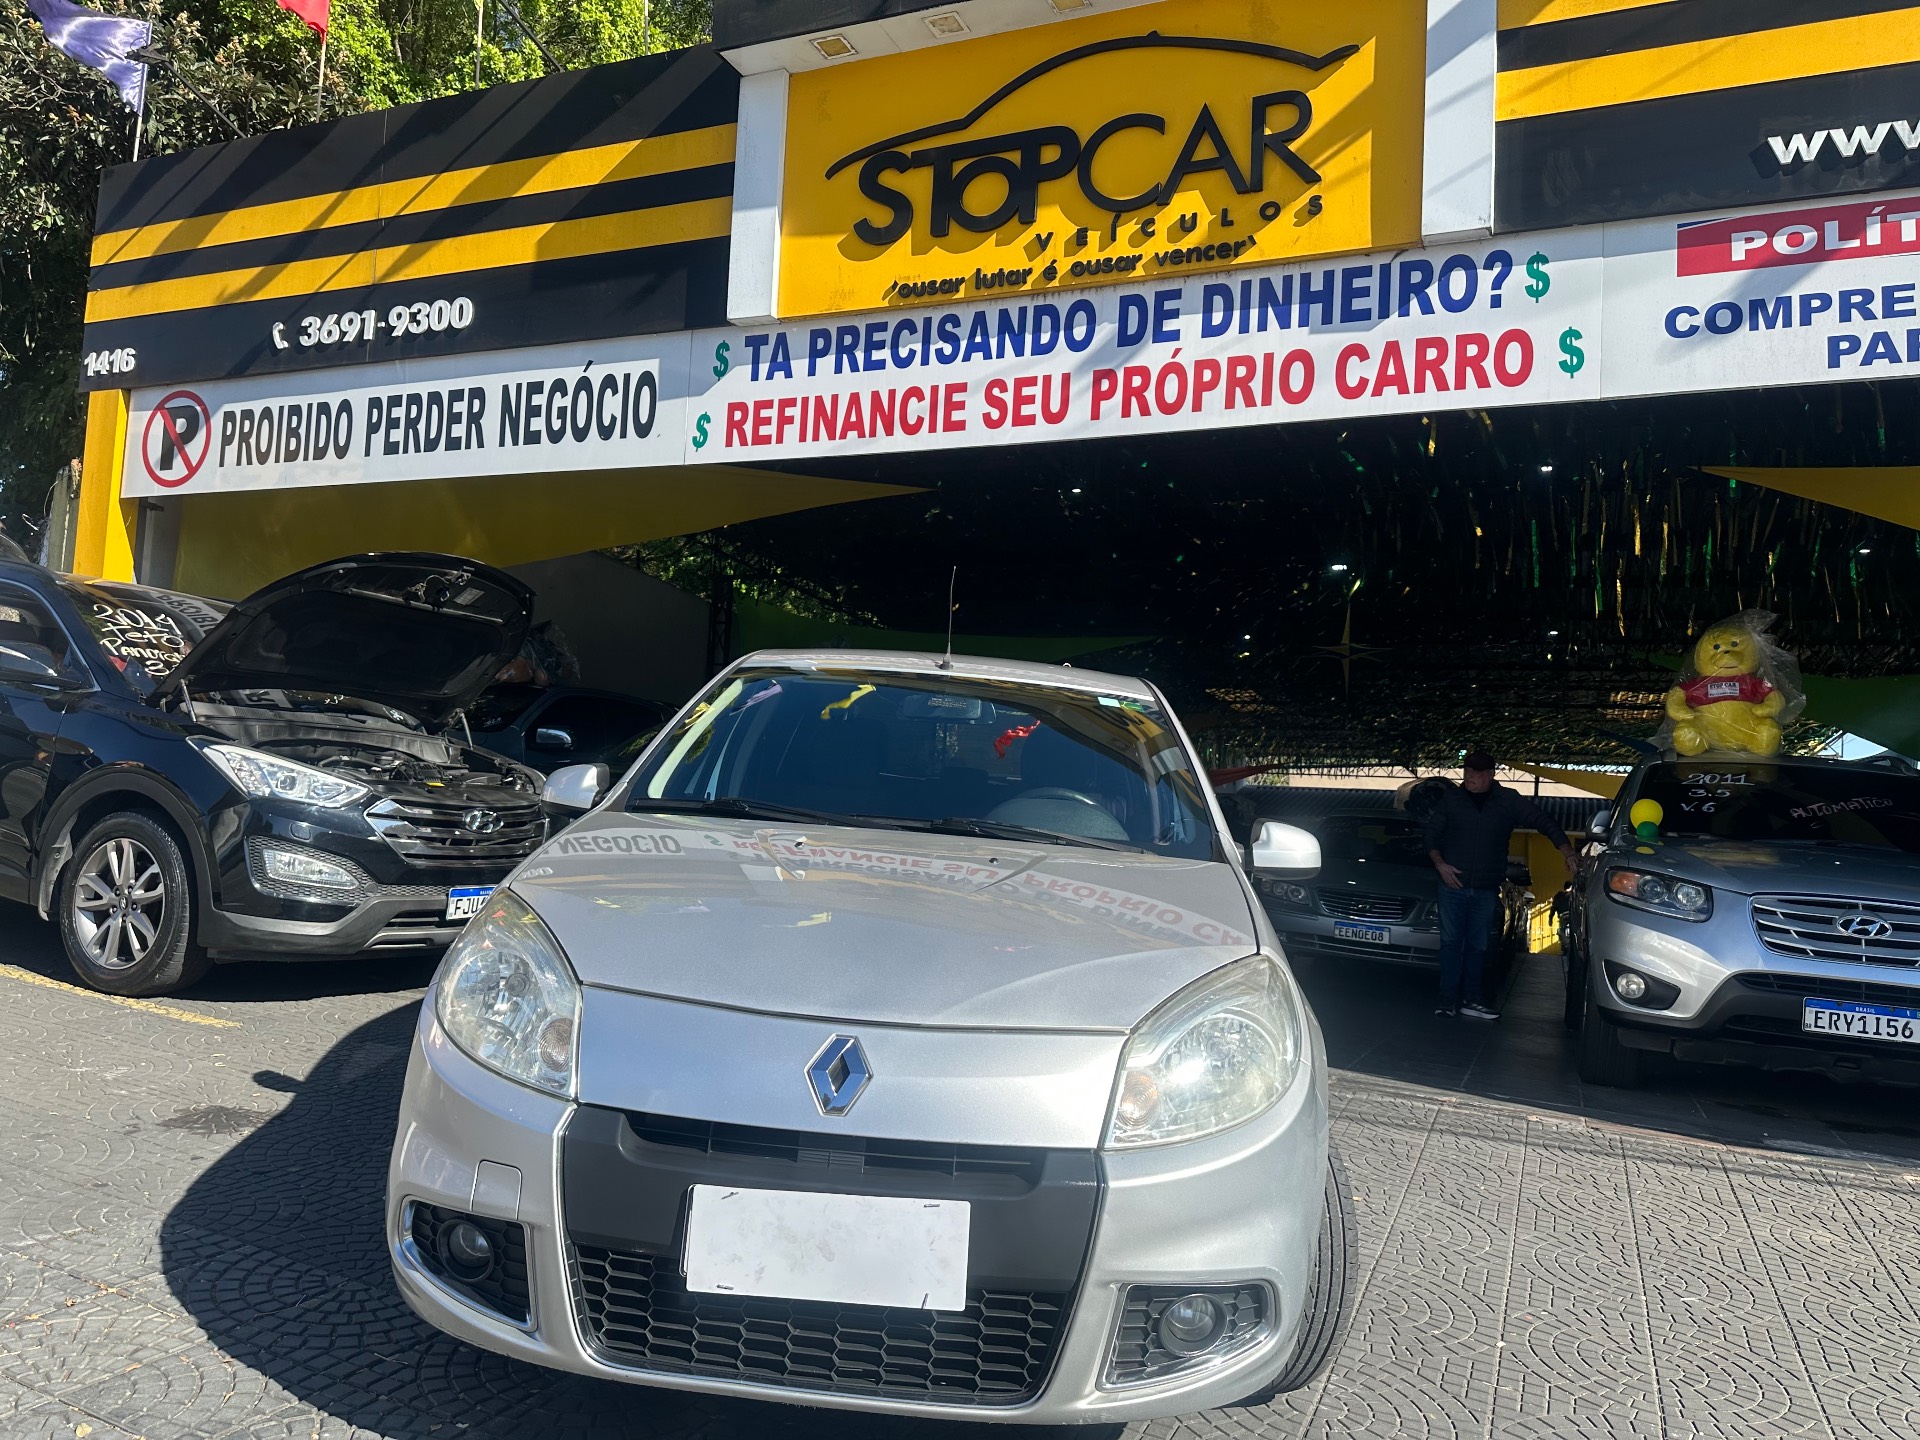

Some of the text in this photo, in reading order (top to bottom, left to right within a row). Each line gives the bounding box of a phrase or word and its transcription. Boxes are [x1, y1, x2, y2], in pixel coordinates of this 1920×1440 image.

[1035, 195, 1323, 251] VEÍCULOS
[975, 266, 1035, 290] lutar
[1043, 259, 1058, 281] é
[1070, 251, 1144, 278] ousar
[299, 297, 474, 347] 3691-9300
[745, 332, 794, 382] TA
[807, 297, 1097, 377] PRECISANDO
[1116, 288, 1183, 348] DE
[1201, 249, 1514, 339] DINHEIRO?
[84, 347, 136, 377] 1416
[724, 381, 968, 449] REFINANCIE
[981, 372, 1072, 431] SEU
[1089, 347, 1316, 421] PRÓPRIO
[1335, 328, 1534, 400] CARRO
[219, 398, 353, 468] PROIBIDO
[364, 386, 486, 457] PERDER
[498, 360, 658, 448] NEGÓCIO
[1682, 773, 1755, 786] 2011
[1855, 1006, 1876, 1014] BRASIL
